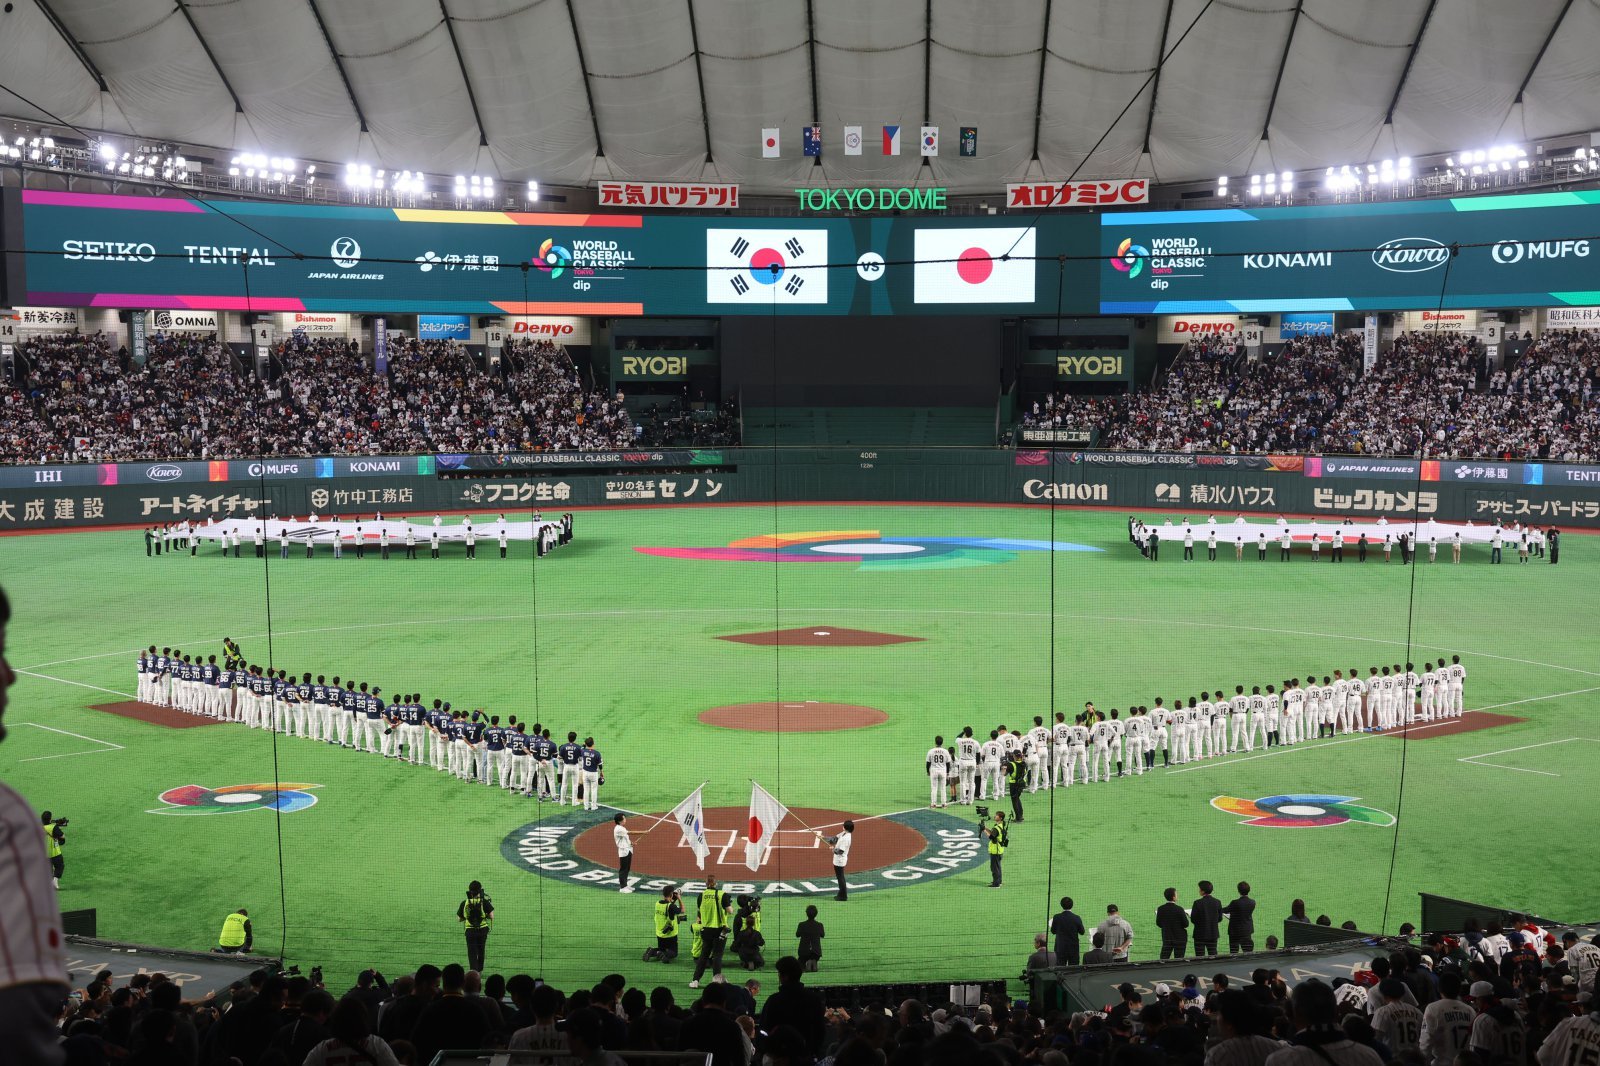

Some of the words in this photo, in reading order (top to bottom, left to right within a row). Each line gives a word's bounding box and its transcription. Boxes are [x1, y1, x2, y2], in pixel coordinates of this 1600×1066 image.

[795, 187, 876, 211] TOKYO
[878, 186, 947, 210] DOME
[1010, 179, 1146, 207] オロナミンC
[572, 240, 618, 251] WORLD
[1151, 238, 1198, 249] WORLD
[1528, 239, 1590, 259] MUFG
[63, 240, 156, 262] SEIKO
[573, 250, 635, 261] BASEBALL
[1151, 247, 1214, 258] BASEBALL
[1378, 245, 1446, 264] Kowa
[442, 254, 499, 272] 伊藤園
[572, 260, 625, 271] CLASSIC
[861, 260, 880, 272] VS
[1151, 257, 1205, 269] CLASSIC
[1243, 252, 1332, 269] KONAMI
[573, 280, 591, 291] dip
[1150, 279, 1169, 291] dip
[295, 313, 337, 323] Bishamon
[1422, 311, 1465, 321] Bishamon
[175, 317, 216, 327] OMNIA
[420, 322, 470, 333] 文化シャッター
[1282, 321, 1333, 332] 文化シャッター
[2, 325, 13, 336] 14
[513, 321, 574, 337] Denyo
[1173, 321, 1235, 335] Denyo
[1488, 327, 1495, 337] 3
[260, 329, 267, 339] 4
[491, 332, 501, 341] 16
[1246, 331, 1258, 340] 34
[622, 356, 687, 376] RYOBI
[1057, 355, 1122, 375] RYOBI
[511, 455, 542, 464] WORLD
[542, 454, 585, 463] BASEBALL
[584, 454, 621, 462] CLASSIC
[623, 453, 650, 461] TOKYO
[651, 453, 664, 461] dip
[860, 451, 878, 459] 400ft
[1084, 454, 1114, 463] WORLD
[1115, 455, 1157, 464] BASEBALL
[1158, 456, 1194, 464] CLASSIC
[1226, 458, 1239, 466] dip
[267, 464, 298, 474] MUFG
[350, 461, 400, 472] KONAMI
[1369, 466, 1414, 474] AIRLINES
[35, 470, 62, 483] IHI
[150, 467, 181, 478] Kowa
[1471, 466, 1508, 479] 伊藤園
[606, 480, 656, 492] 守りの名手
[659, 478, 723, 498] セノン
[1023, 479, 1108, 500] Canon
[333, 487, 414, 505] 竹中工務店
[485, 481, 571, 503] フコク生命
[1190, 483, 1276, 506] 積水ハウス
[140, 494, 272, 516] アートネイチャー
[1313, 487, 1438, 513] ビックカメラ
[0, 498, 105, 522] 大成建設
[171, 665, 179, 673] 77
[181, 671, 190, 679] 72
[191, 671, 200, 679] 70
[204, 671, 213, 679] 99
[1352, 683, 1361, 692] 46
[1372, 681, 1380, 690] 47
[1427, 678, 1434, 686] 77
[299, 689, 310, 698] 47
[328, 692, 339, 701] 33
[1311, 690, 1320, 699] 26
[367, 703, 377, 713] 25
[1253, 700, 1263, 709] 20
[409, 711, 418, 721] 14
[1201, 707, 1209, 716] 15
[441, 719, 447, 729] 8
[1158, 714, 1164, 723] 7
[1176, 715, 1185, 724] 13
[456, 728, 463, 737] 3
[1132, 723, 1137, 731] 4
[469, 730, 475, 740] 7
[492, 733, 499, 743] 2
[1037, 732, 1046, 742] 25
[512, 741, 523, 751] 23
[963, 744, 973, 754] 16
[1005, 739, 1014, 749] 51
[540, 747, 549, 757] 15
[567, 750, 574, 760] 5
[991, 747, 997, 756] 8
[585, 757, 592, 767] 6
[518, 826, 579, 871] WORLD
[568, 868, 876, 895] BASEBALL
[880, 827, 983, 881] CLASSIC
[1444, 1010, 1472, 1023] OHTANI
[1398, 1021, 1417, 1045] 16
[1451, 1025, 1469, 1050] 17
